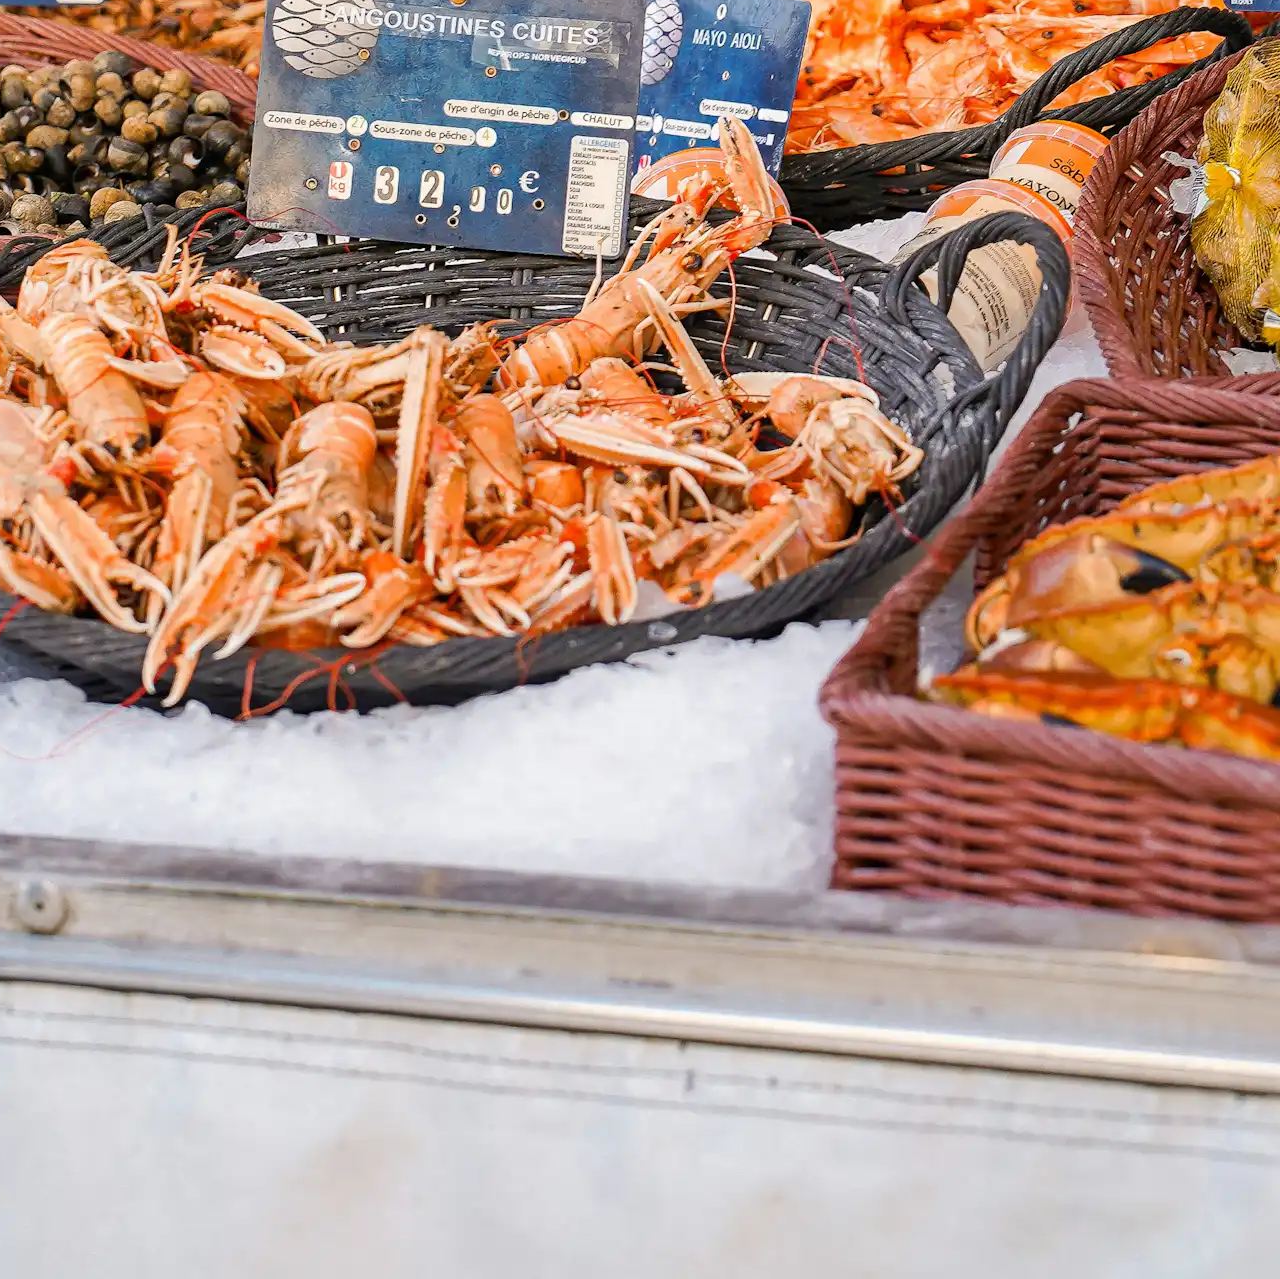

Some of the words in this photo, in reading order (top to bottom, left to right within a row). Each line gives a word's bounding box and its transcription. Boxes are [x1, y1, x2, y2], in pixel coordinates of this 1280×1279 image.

[320, 4, 506, 39] LANGOUSTINES
[512, 22, 599, 46] CUITES
[693, 29, 727, 48] MAYO
[730, 32, 762, 50] AIOLI
[487, 47, 530, 61] NEPHROPS
[531, 51, 587, 64] NORVEGICUS
[447, 103, 468, 114] Type
[507, 108, 519, 117] de
[521, 109, 550, 120] pêche
[582, 113, 623, 127] CHALUT
[268, 114, 292, 124] Zone
[294, 116, 307, 125] de
[309, 118, 338, 129] pêche
[373, 124, 422, 136] Sous-zone
[424, 129, 437, 138] de
[439, 131, 467, 141] pêche
[481, 129, 490, 140] 4
[330, 180, 346, 193] kg
[518, 170, 541, 194] €
